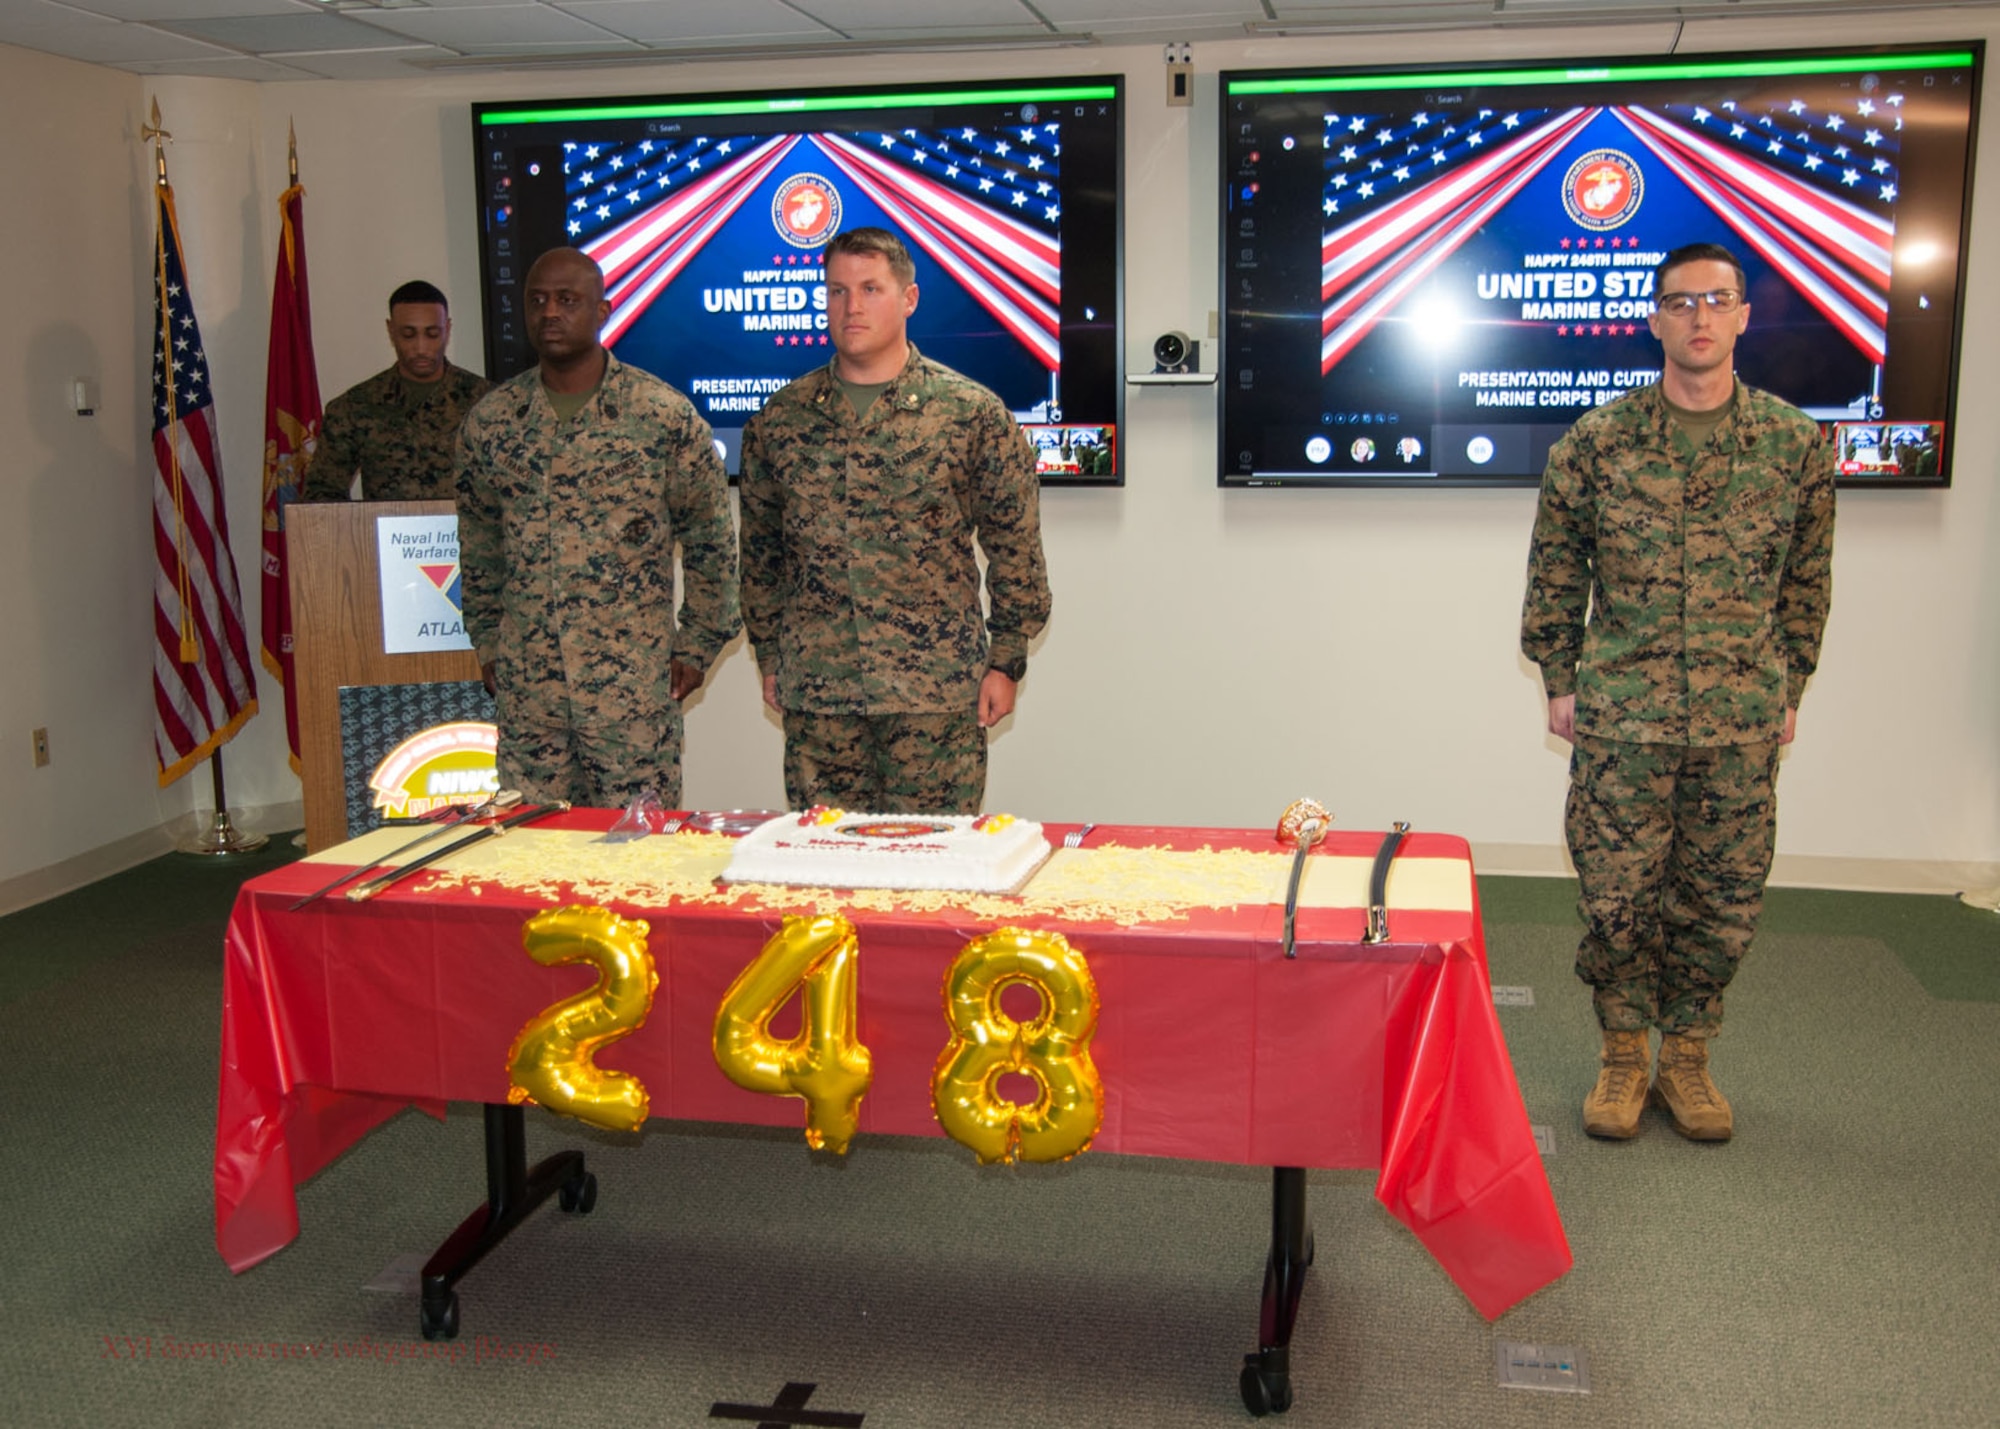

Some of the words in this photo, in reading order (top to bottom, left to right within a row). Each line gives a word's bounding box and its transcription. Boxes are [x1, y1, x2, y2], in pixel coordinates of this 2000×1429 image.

[1437, 94, 1462, 104] Search
[659, 122, 681, 133] Search
[1524, 255, 1569, 268] HAPPY
[1570, 253, 1611, 267] 248TH
[743, 270, 781, 283] HAPPY
[1477, 272, 1597, 299] UNITED
[703, 287, 808, 313] UNITED
[1521, 302, 1602, 319] MARINE
[743, 314, 813, 331] MARINE
[1458, 372, 1572, 387] PRESENTATION
[1575, 371, 1610, 386] AND
[1613, 369, 1661, 387] CUTTI
[708, 397, 761, 412] MARINE
[1475, 391, 1535, 406] MARINE
[1538, 391, 1592, 406] CORPS
[391, 531, 432, 545] Naval
[402, 546, 458, 559] Warfare
[417, 621, 465, 637] ATLA
[507, 905, 658, 1132] 2
[713, 913, 873, 1154] 4
[932, 926, 1103, 1165] 8
